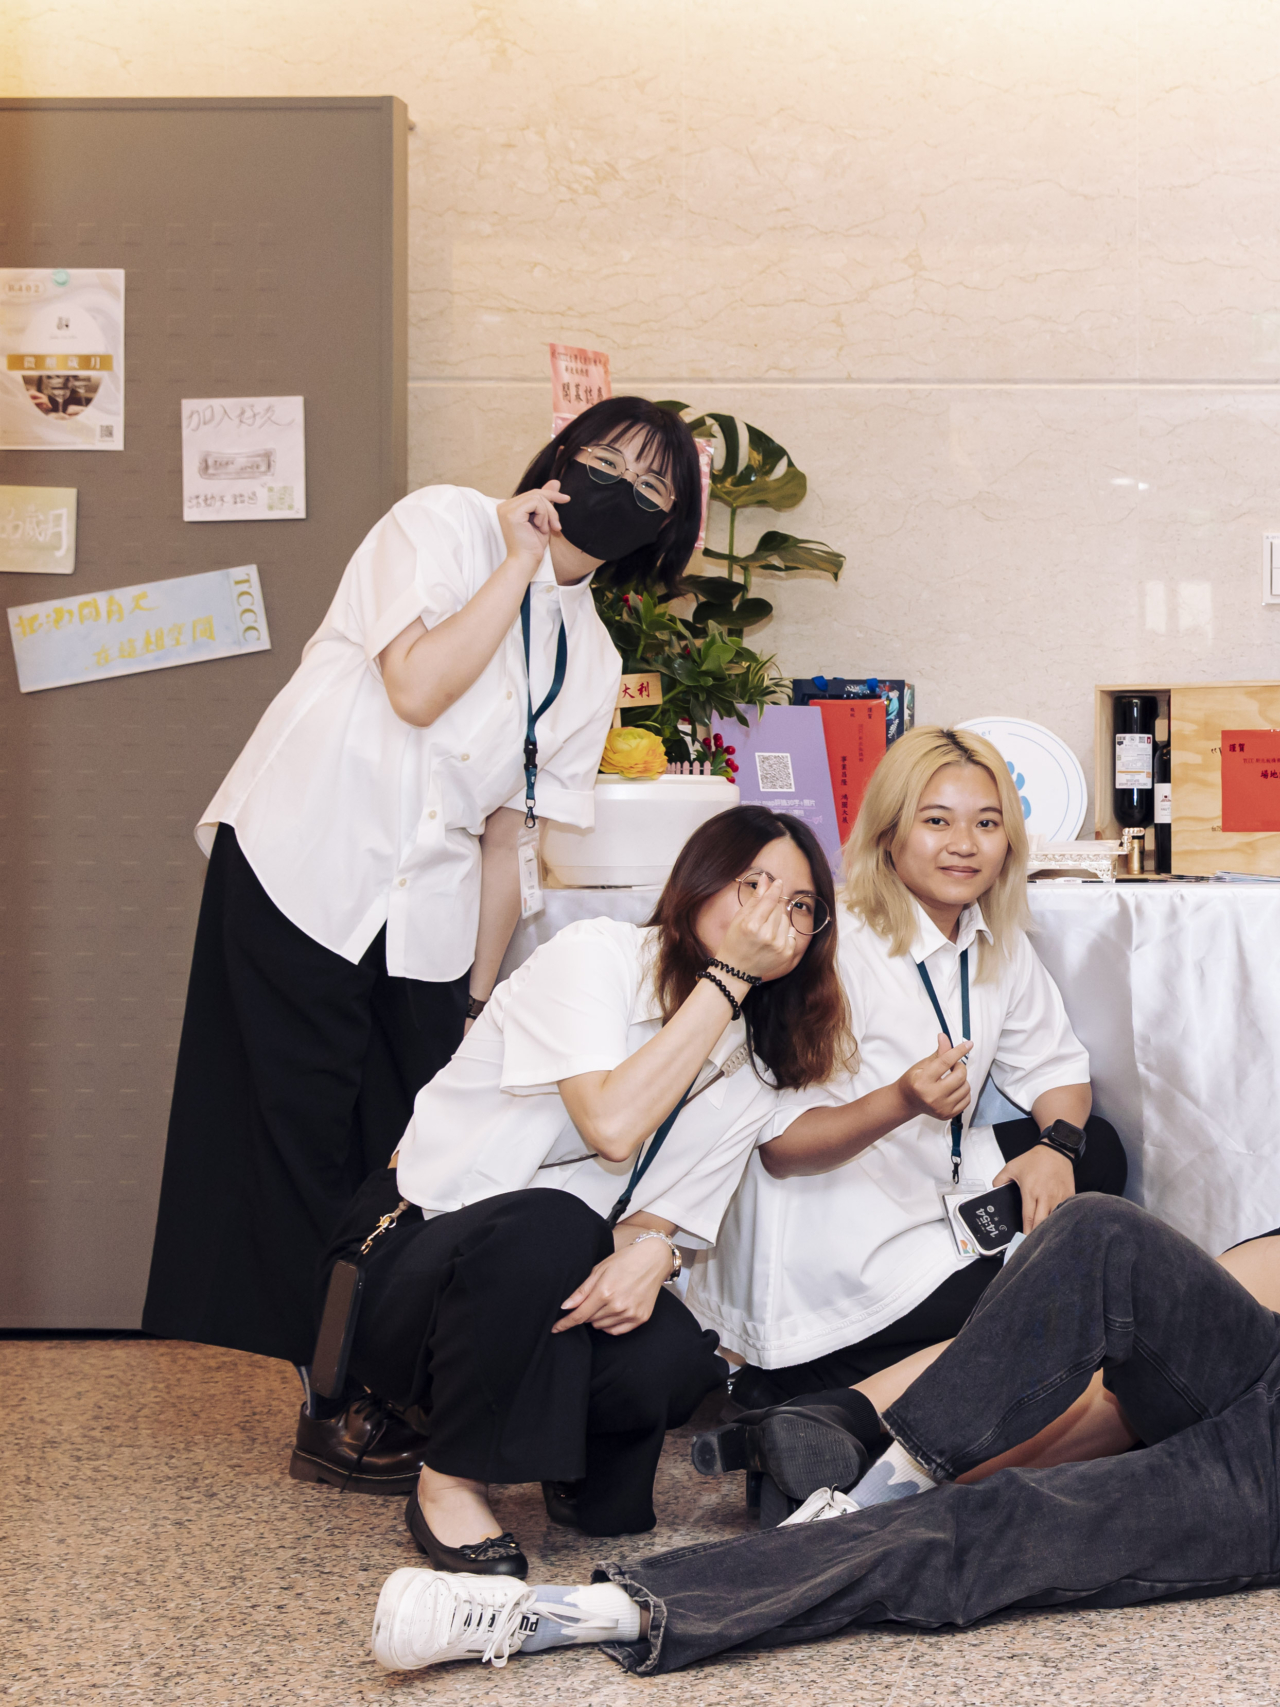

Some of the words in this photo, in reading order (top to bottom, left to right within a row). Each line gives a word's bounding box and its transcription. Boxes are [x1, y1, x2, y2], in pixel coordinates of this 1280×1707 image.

[234, 573, 262, 642] TCCC
[621, 681, 651, 699] 大利
[1229, 743, 1246, 753] 謹賀
[975, 1208, 999, 1238] 14:54
